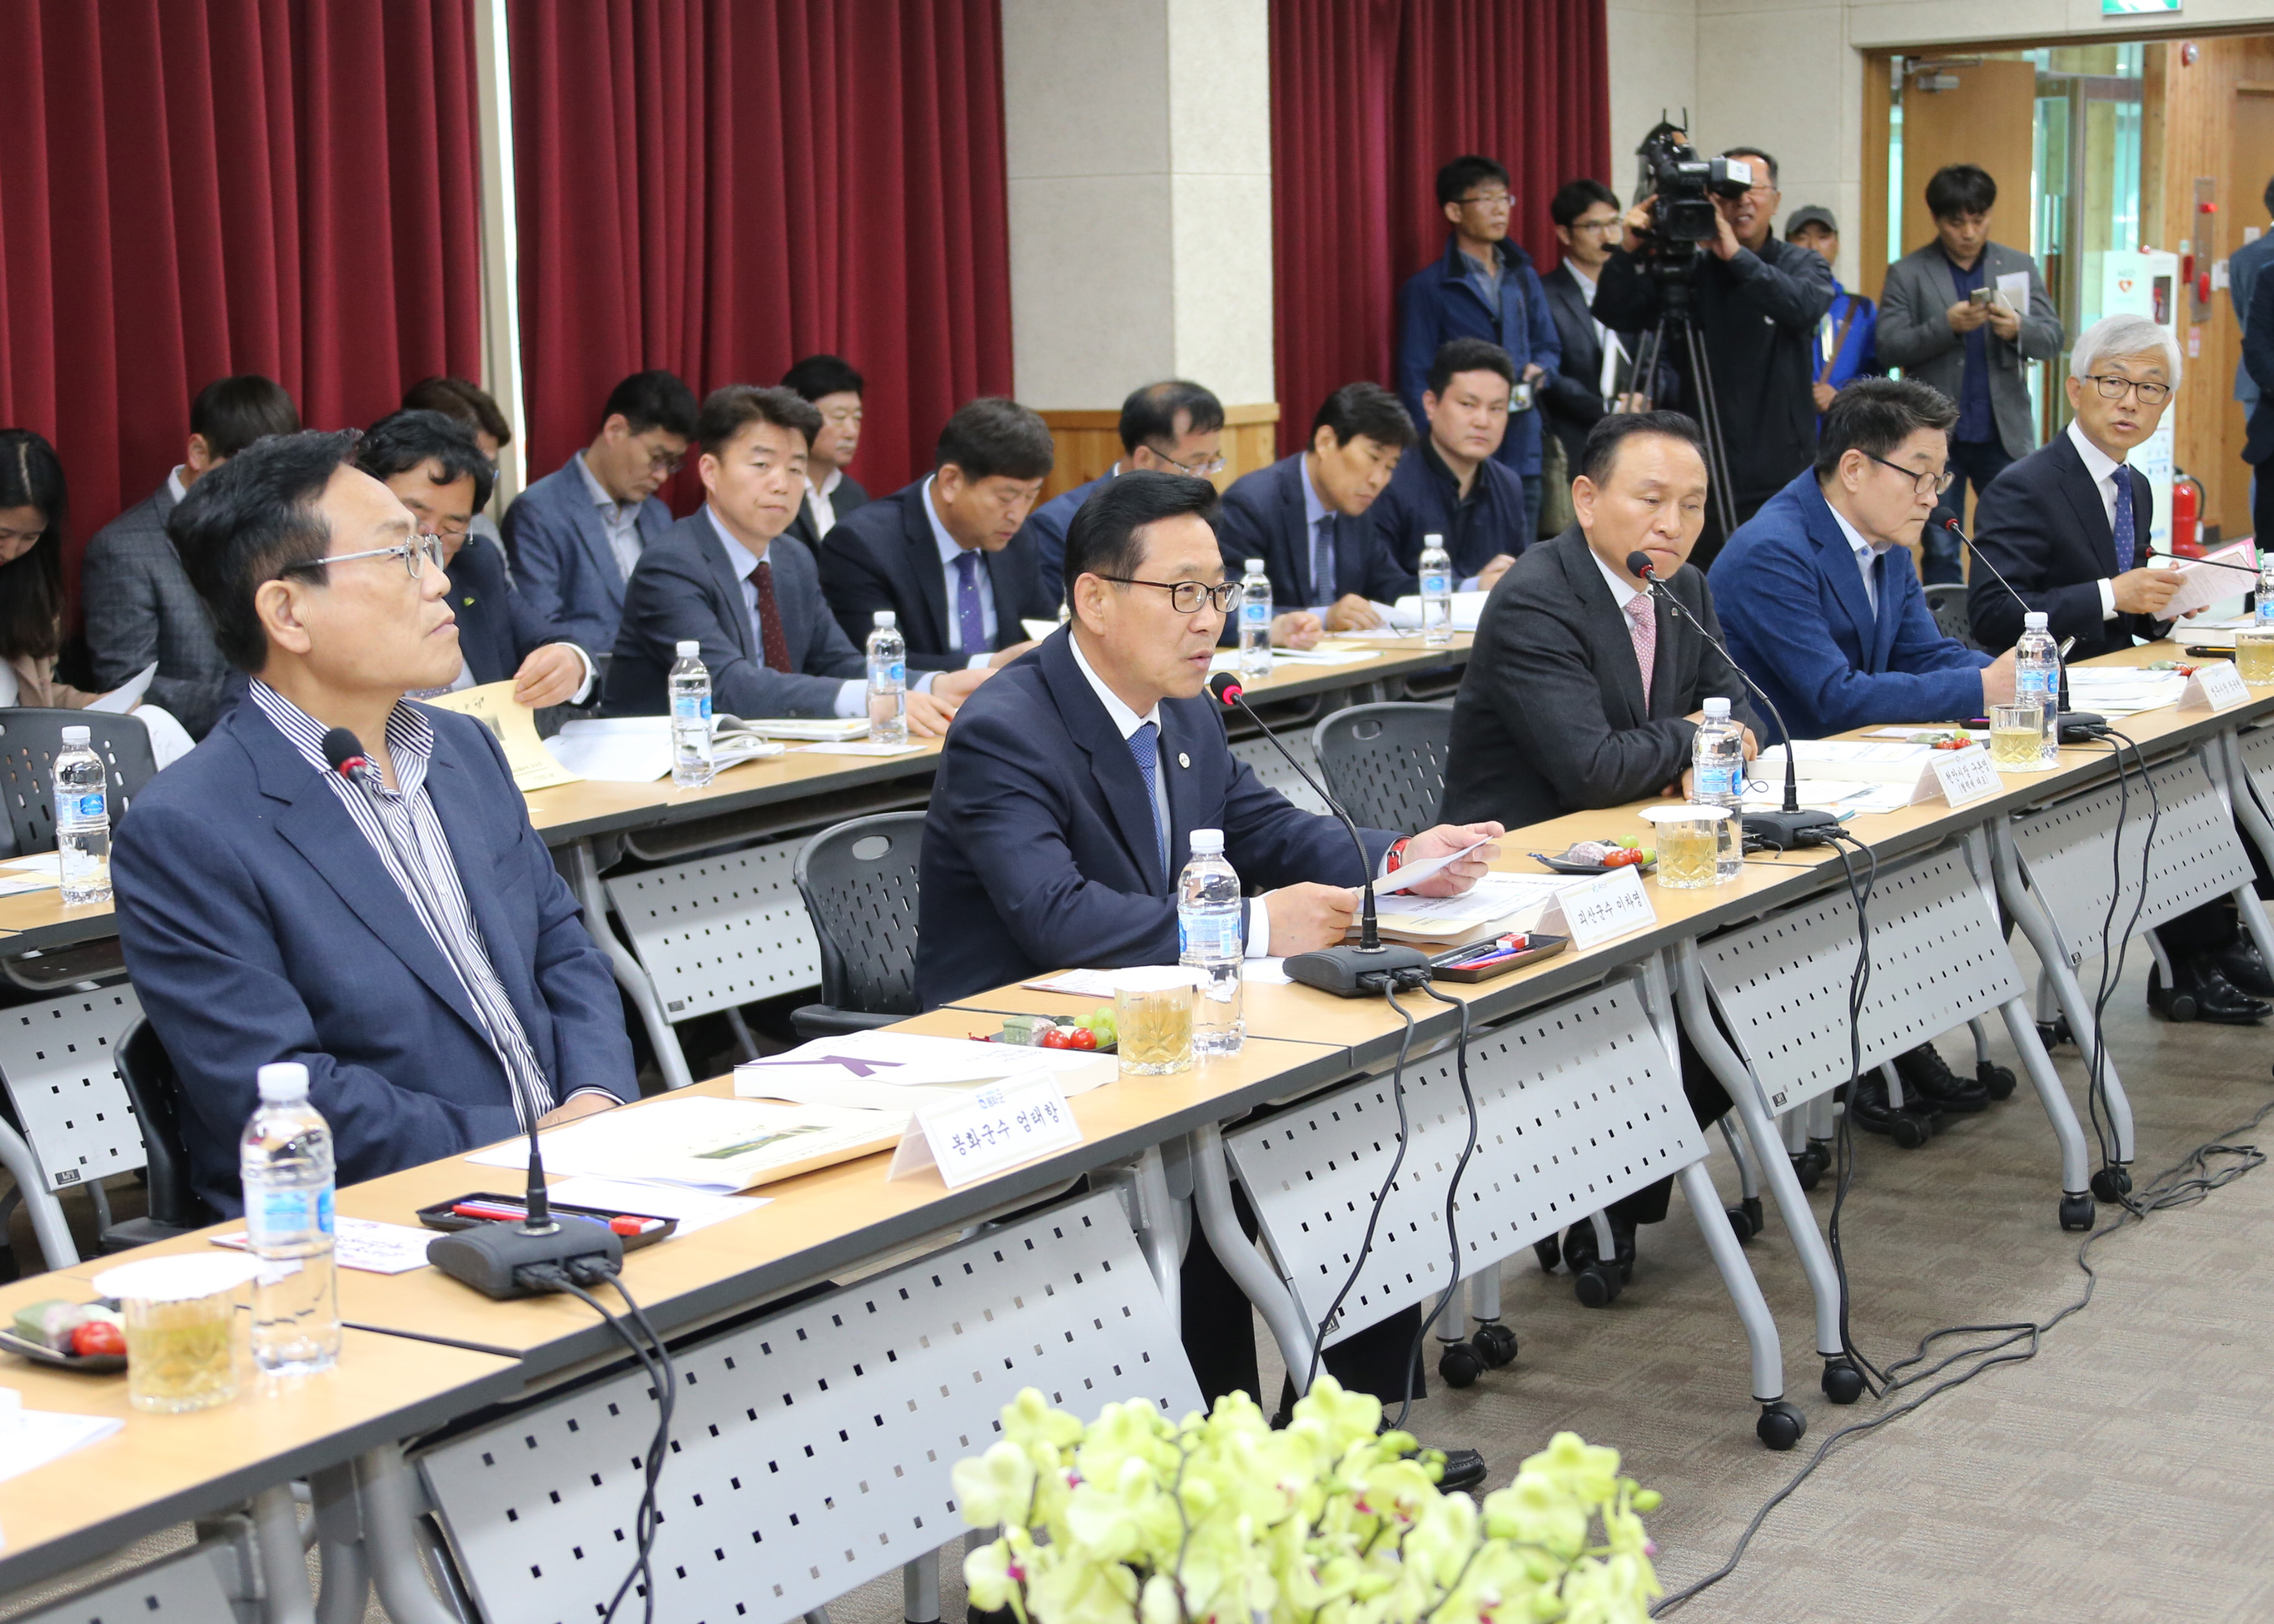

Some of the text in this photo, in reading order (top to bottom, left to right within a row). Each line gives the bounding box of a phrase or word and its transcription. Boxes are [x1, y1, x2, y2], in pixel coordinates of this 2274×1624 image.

[1945, 758, 1990, 784] 천안시장 구본영
[1578, 890, 1643, 927] 괴산군수 이차영
[985, 1092, 1006, 1107] 봉화군
[951, 1101, 1060, 1157] 봉화군수 엄태항
